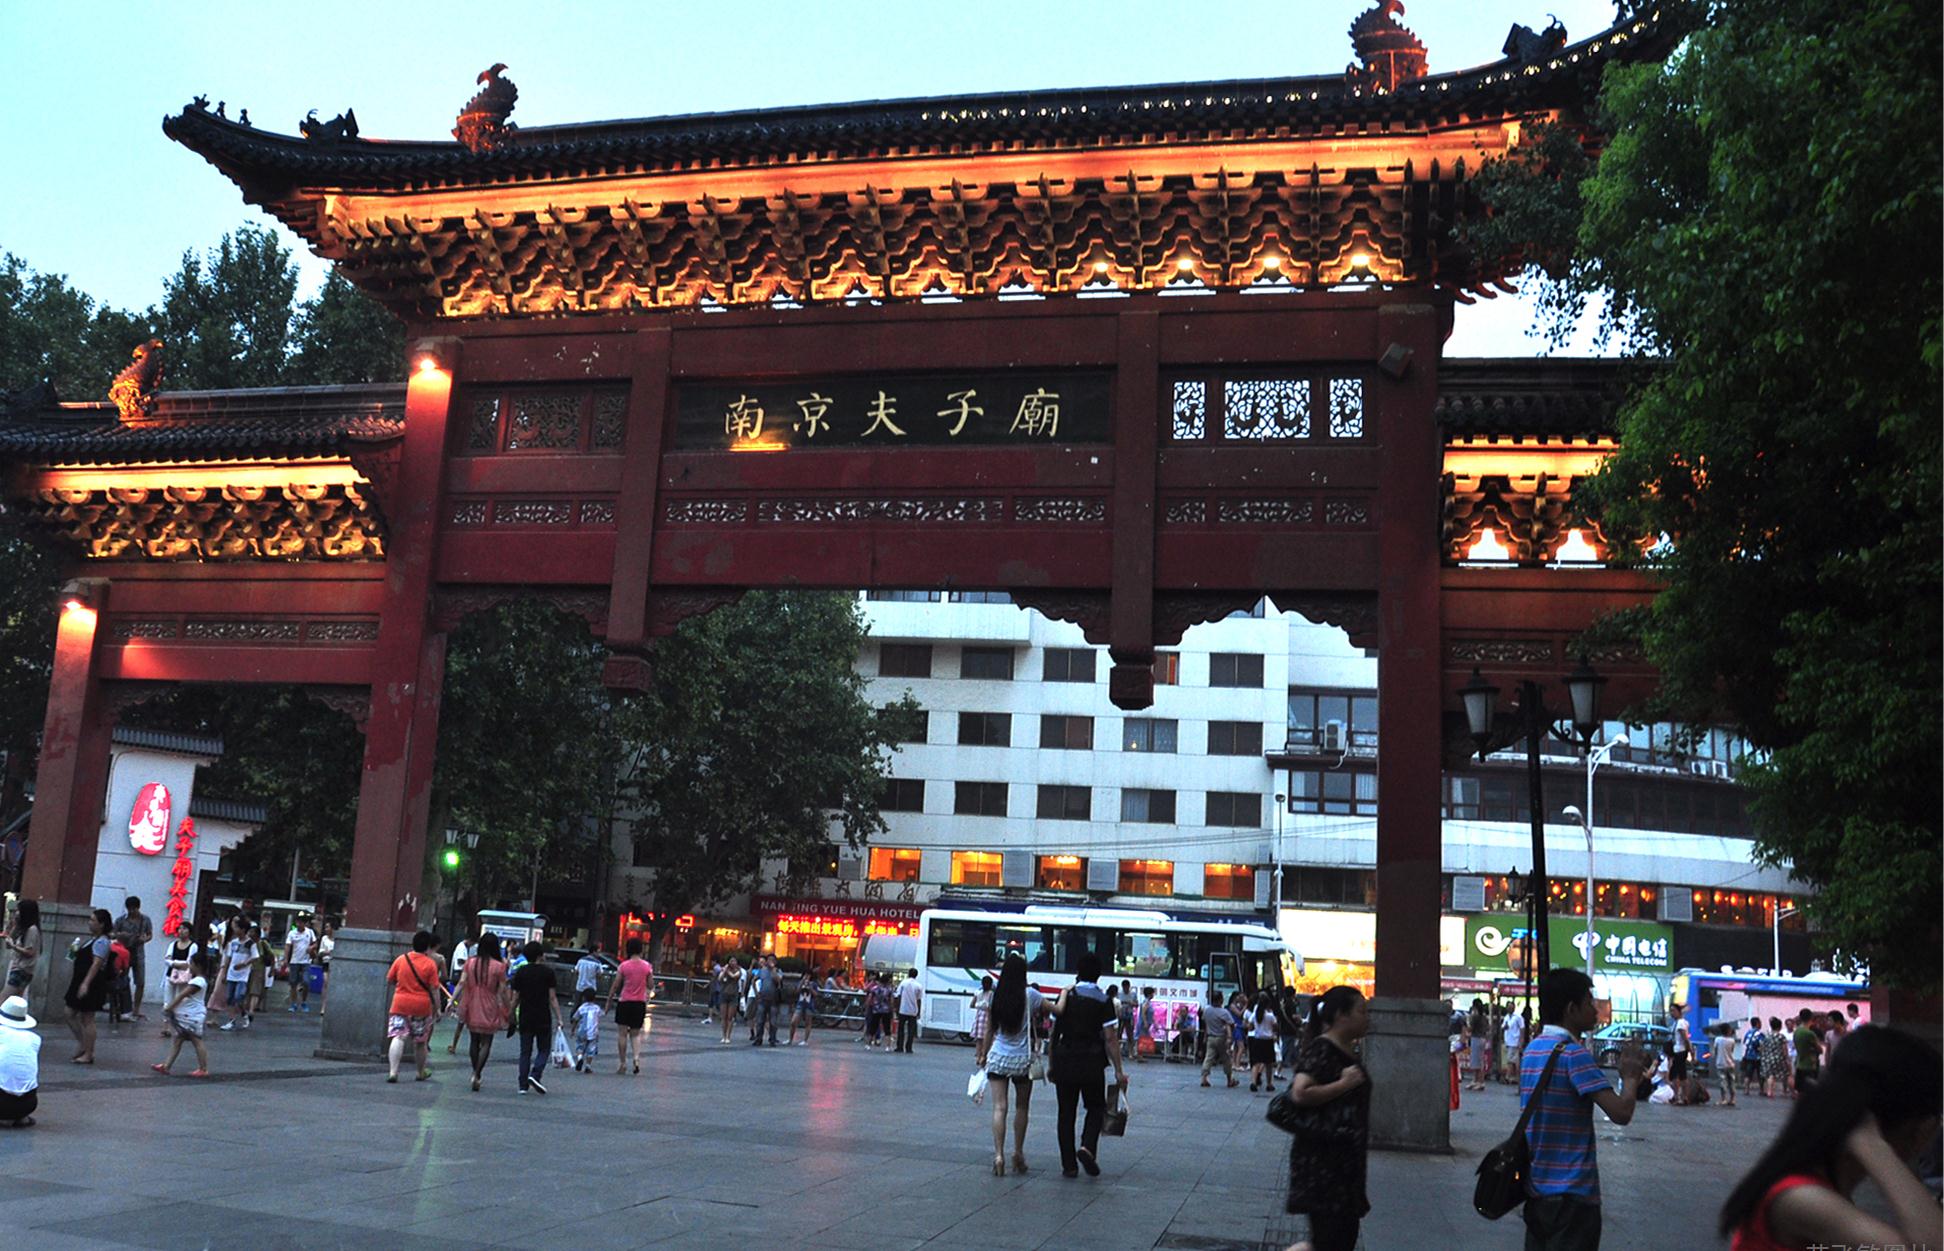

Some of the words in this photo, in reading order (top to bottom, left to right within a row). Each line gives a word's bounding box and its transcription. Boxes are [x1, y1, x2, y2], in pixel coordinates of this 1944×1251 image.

[723, 387, 1062, 438] 南京夫子廟
[760, 900, 787, 911] NAN
[823, 904, 846, 915] YUE
[850, 906, 876, 917] HUA
[880, 907, 920, 919] HOTEL
[1605, 934, 1667, 958] 中国电信
[1605, 955, 1631, 964] CHINA
[1632, 957, 1667, 966] TELECOM
